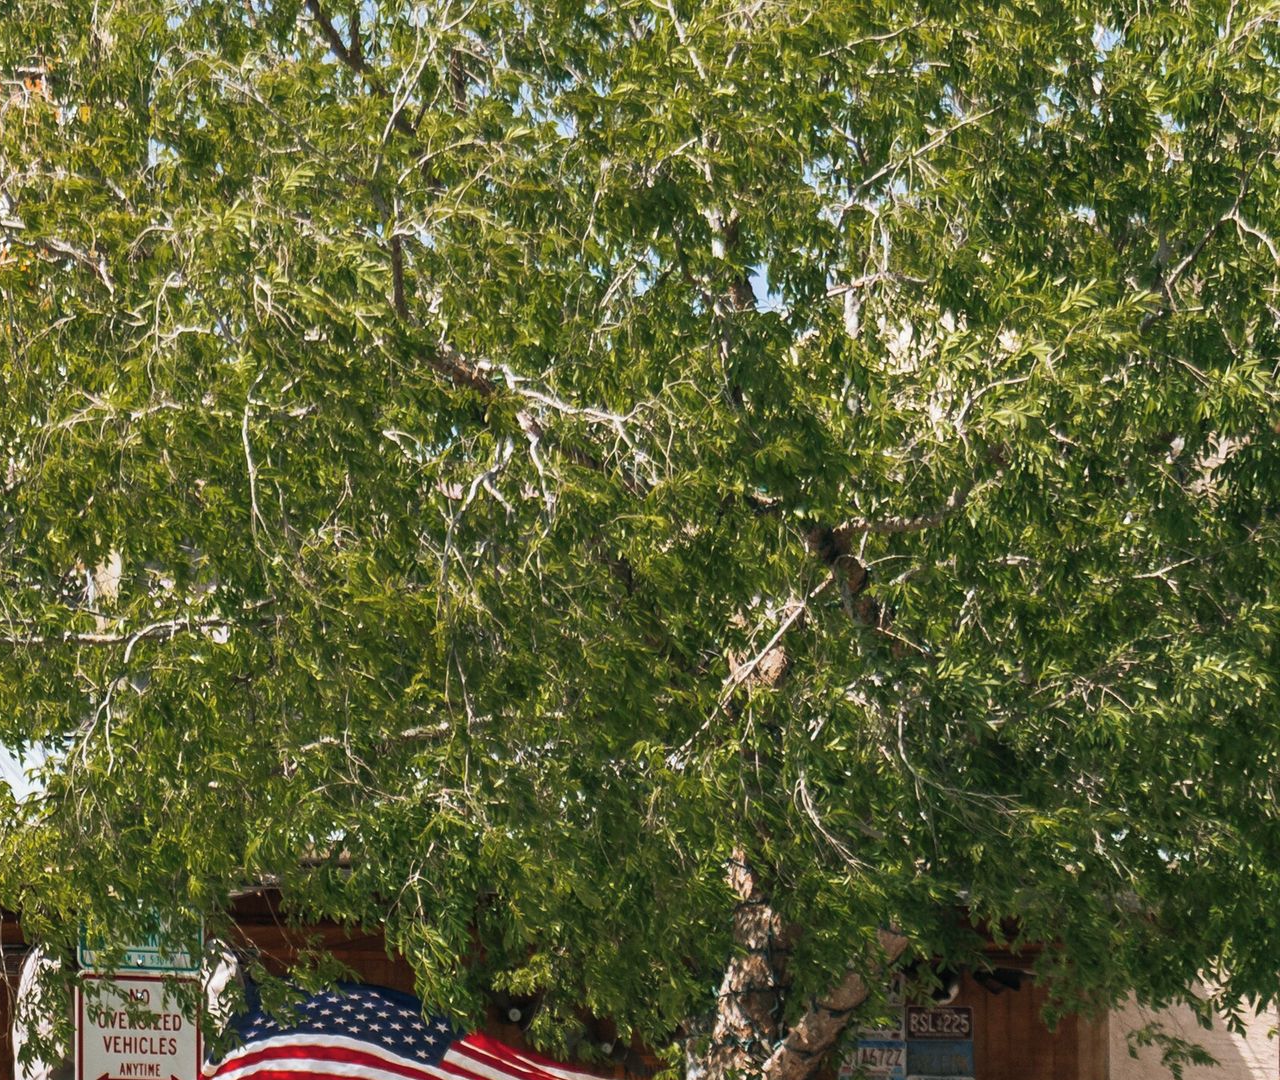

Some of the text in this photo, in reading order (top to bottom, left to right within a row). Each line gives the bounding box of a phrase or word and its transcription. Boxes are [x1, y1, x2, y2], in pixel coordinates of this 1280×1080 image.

[130, 988, 150, 1003] NO
[103, 1036, 177, 1055] VEHICLES
[120, 1062, 161, 1076] ANYTIME
